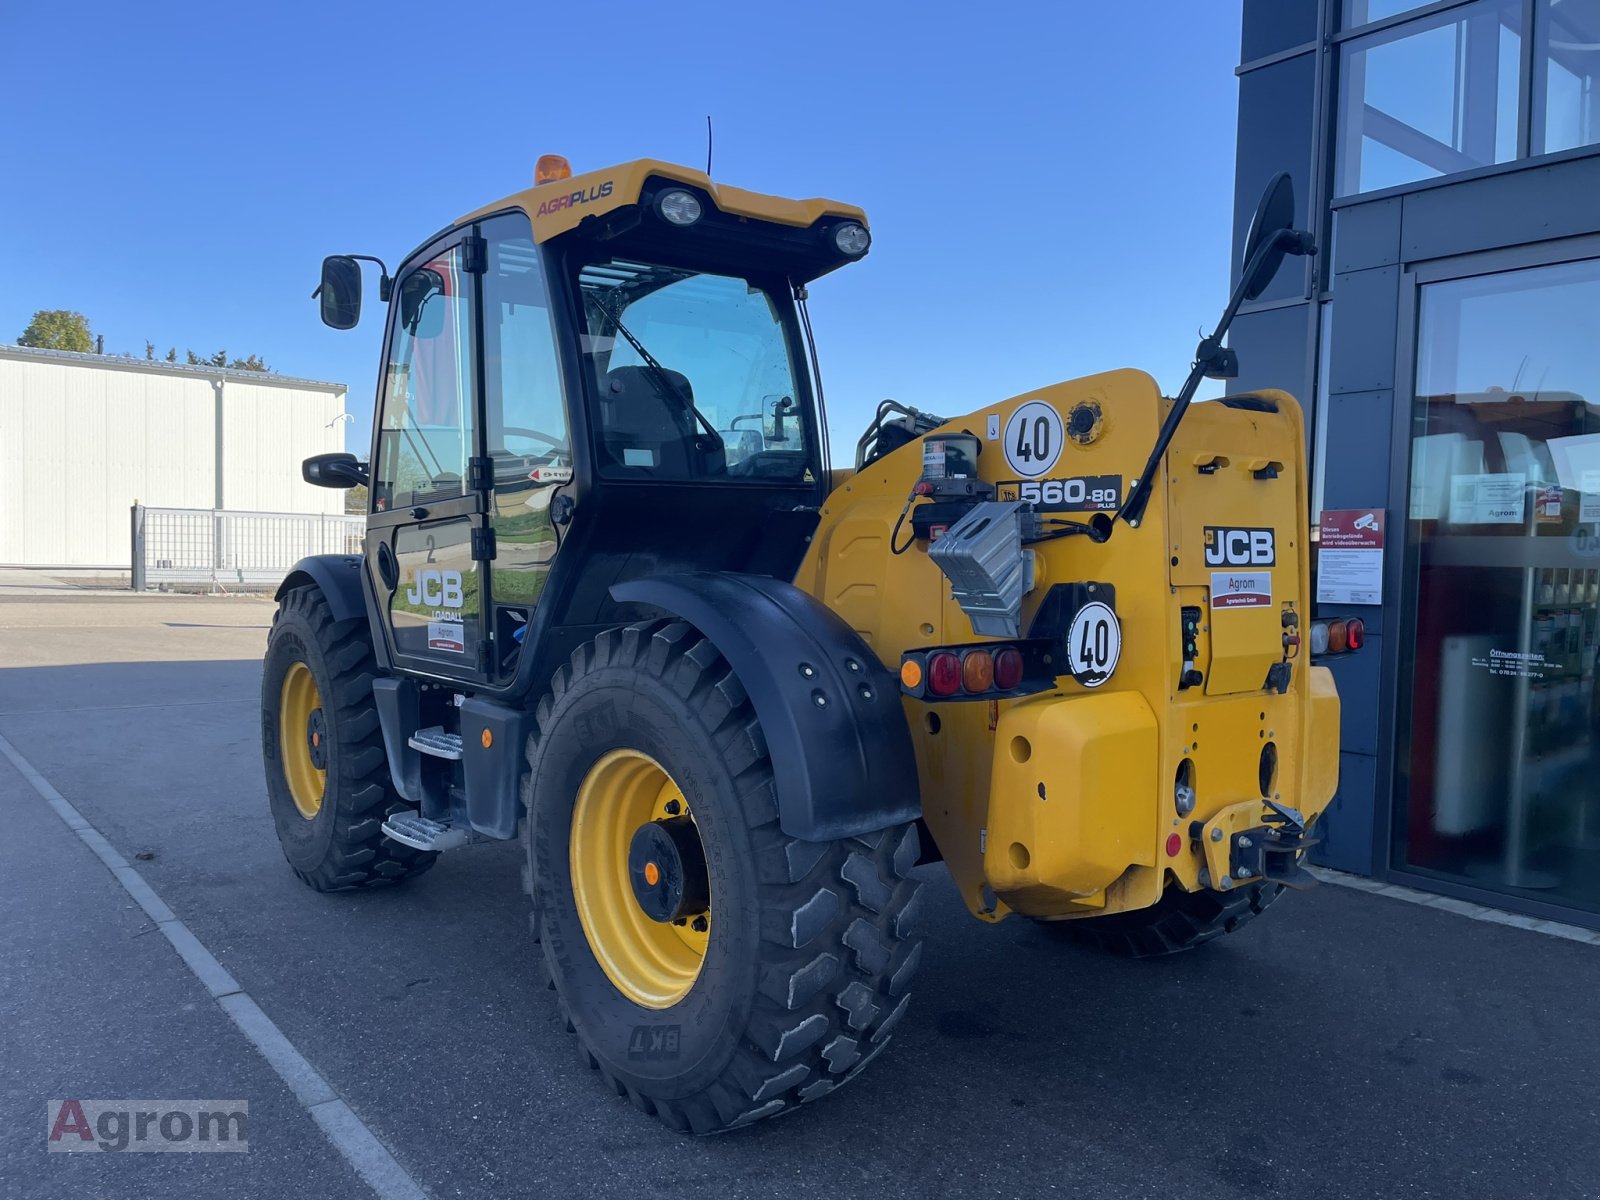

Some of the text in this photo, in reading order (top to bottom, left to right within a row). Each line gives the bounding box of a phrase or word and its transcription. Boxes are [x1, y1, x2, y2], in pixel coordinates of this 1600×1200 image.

[1017, 416, 1050, 462] 40
[1021, 480, 1116, 505] 560-80
[1488, 509, 1517, 518] Agrom
[427, 534, 436, 563] 2
[1205, 530, 1274, 564] JCB
[407, 569, 464, 608] JCB
[1229, 577, 1255, 592] Agrom
[432, 611, 464, 622] LOADALL
[1080, 619, 1108, 668] 40
